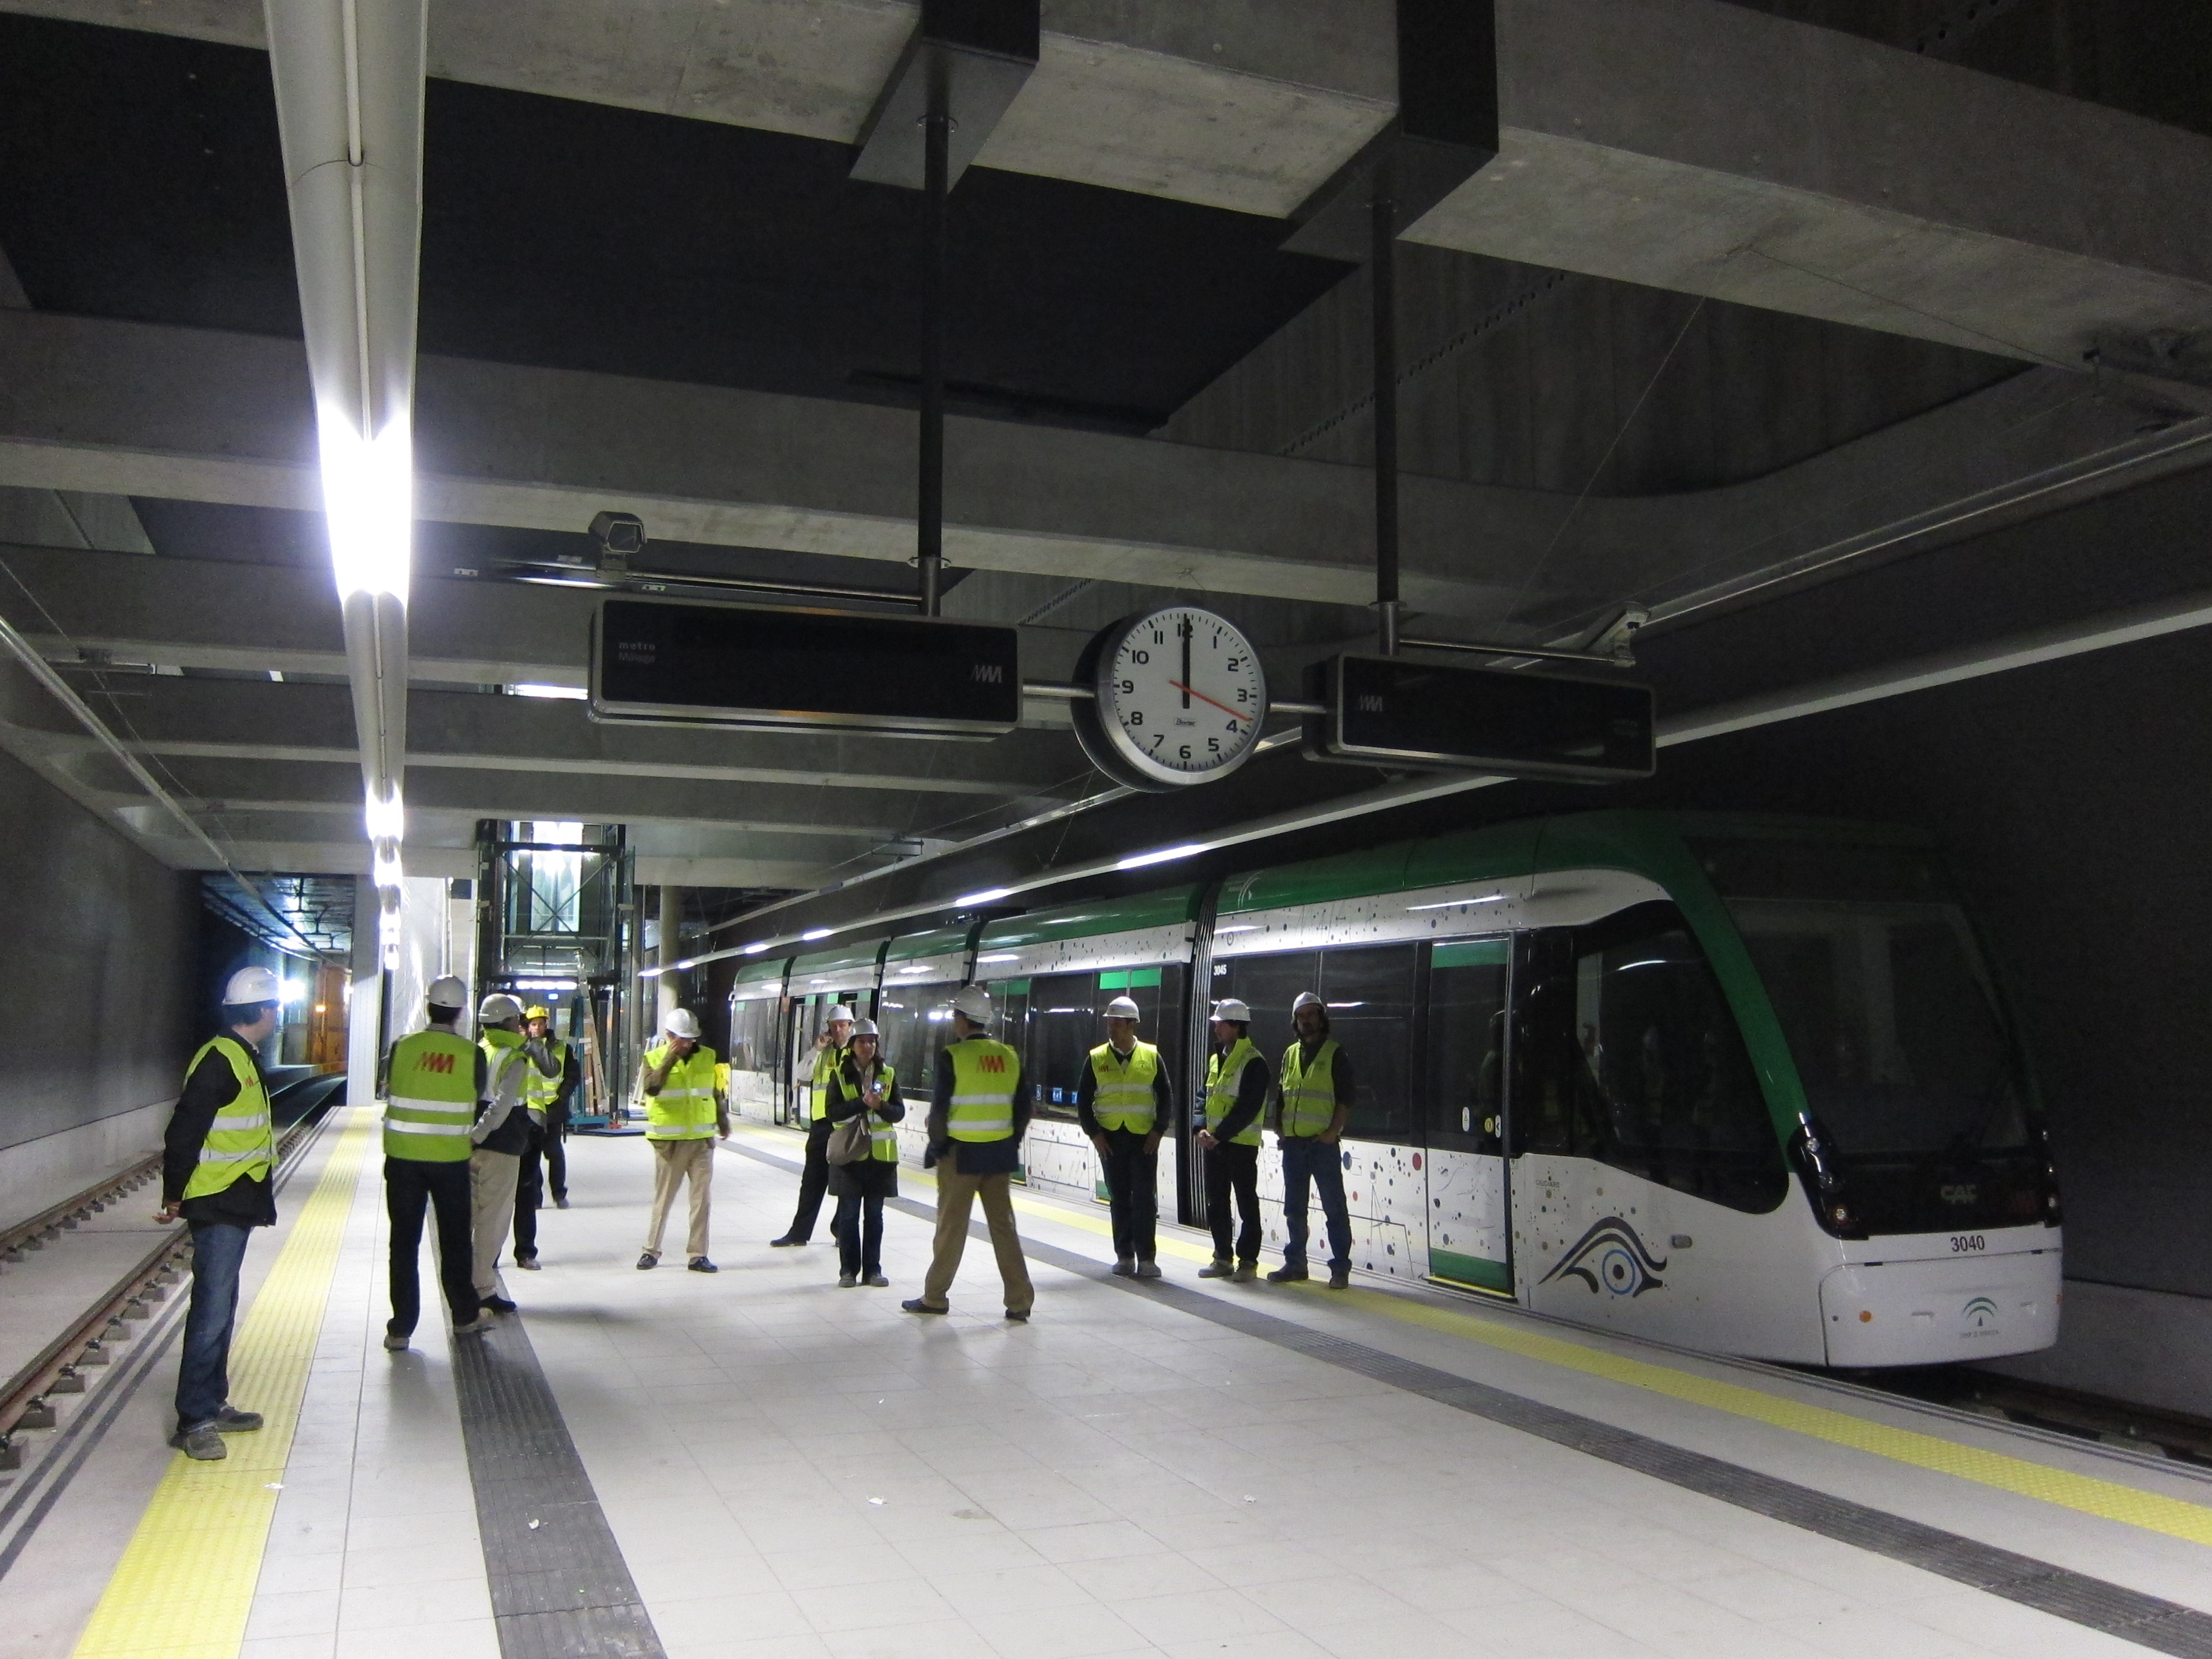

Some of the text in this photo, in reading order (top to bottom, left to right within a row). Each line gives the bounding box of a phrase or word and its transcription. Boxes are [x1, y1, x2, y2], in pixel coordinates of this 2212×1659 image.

[1154, 630, 1164, 645] 11
[1213, 635, 1218, 649] 1
[618, 642, 655, 651] metro
[1131, 649, 1149, 665] 10
[1227, 658, 1239, 672] 2
[1121, 680, 1134, 694] 9
[1237, 688, 1248, 703] 3
[1130, 711, 1144, 725] 8
[1225, 720, 1238, 733] 4
[1153, 734, 1164, 748] 7
[1208, 738, 1219, 752] 5
[1179, 745, 1191, 759] 6
[1213, 964, 1227, 976] 3045
[1951, 1235, 1985, 1252] 3040
